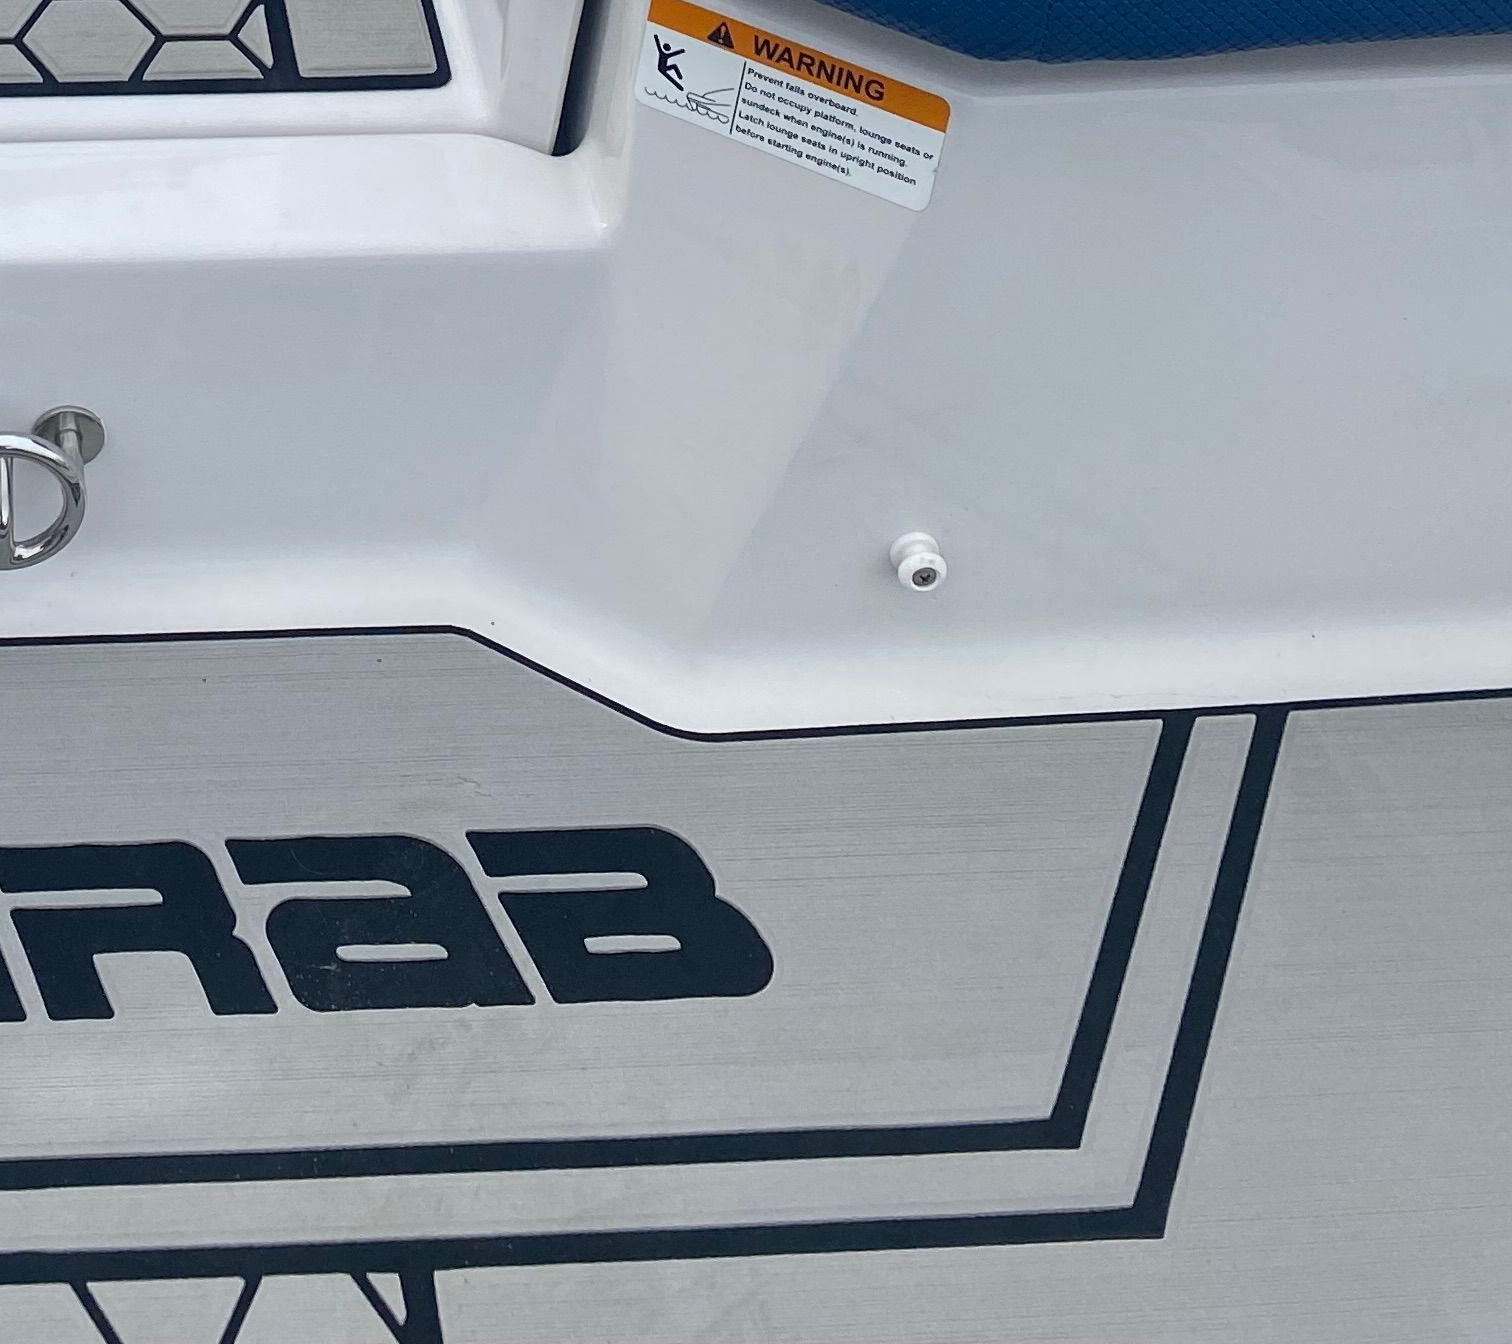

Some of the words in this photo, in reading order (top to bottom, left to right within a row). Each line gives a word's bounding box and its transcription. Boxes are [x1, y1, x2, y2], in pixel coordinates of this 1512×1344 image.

[747, 67, 784, 88] Prevent
[785, 82, 805, 96] falls
[753, 34, 885, 102] WARNING
[735, 124, 765, 142] before
[767, 138, 803, 158] starting
[738, 110, 765, 126] Latch
[766, 121, 799, 140] lounge
[801, 135, 826, 151] seats
[828, 145, 838, 155] in
[840, 151, 875, 170] upright
[876, 165, 917, 186] position
[741, 97, 781, 117] sundeck
[783, 113, 809, 128] when
[857, 141, 866, 150] is
[744, 81, 758, 92] Do
[759, 89, 776, 100] not
[777, 96, 812, 115] occupy
[859, 125, 892, 145] lounge
[894, 141, 921, 156] seats
[923, 152, 934, 160] or
